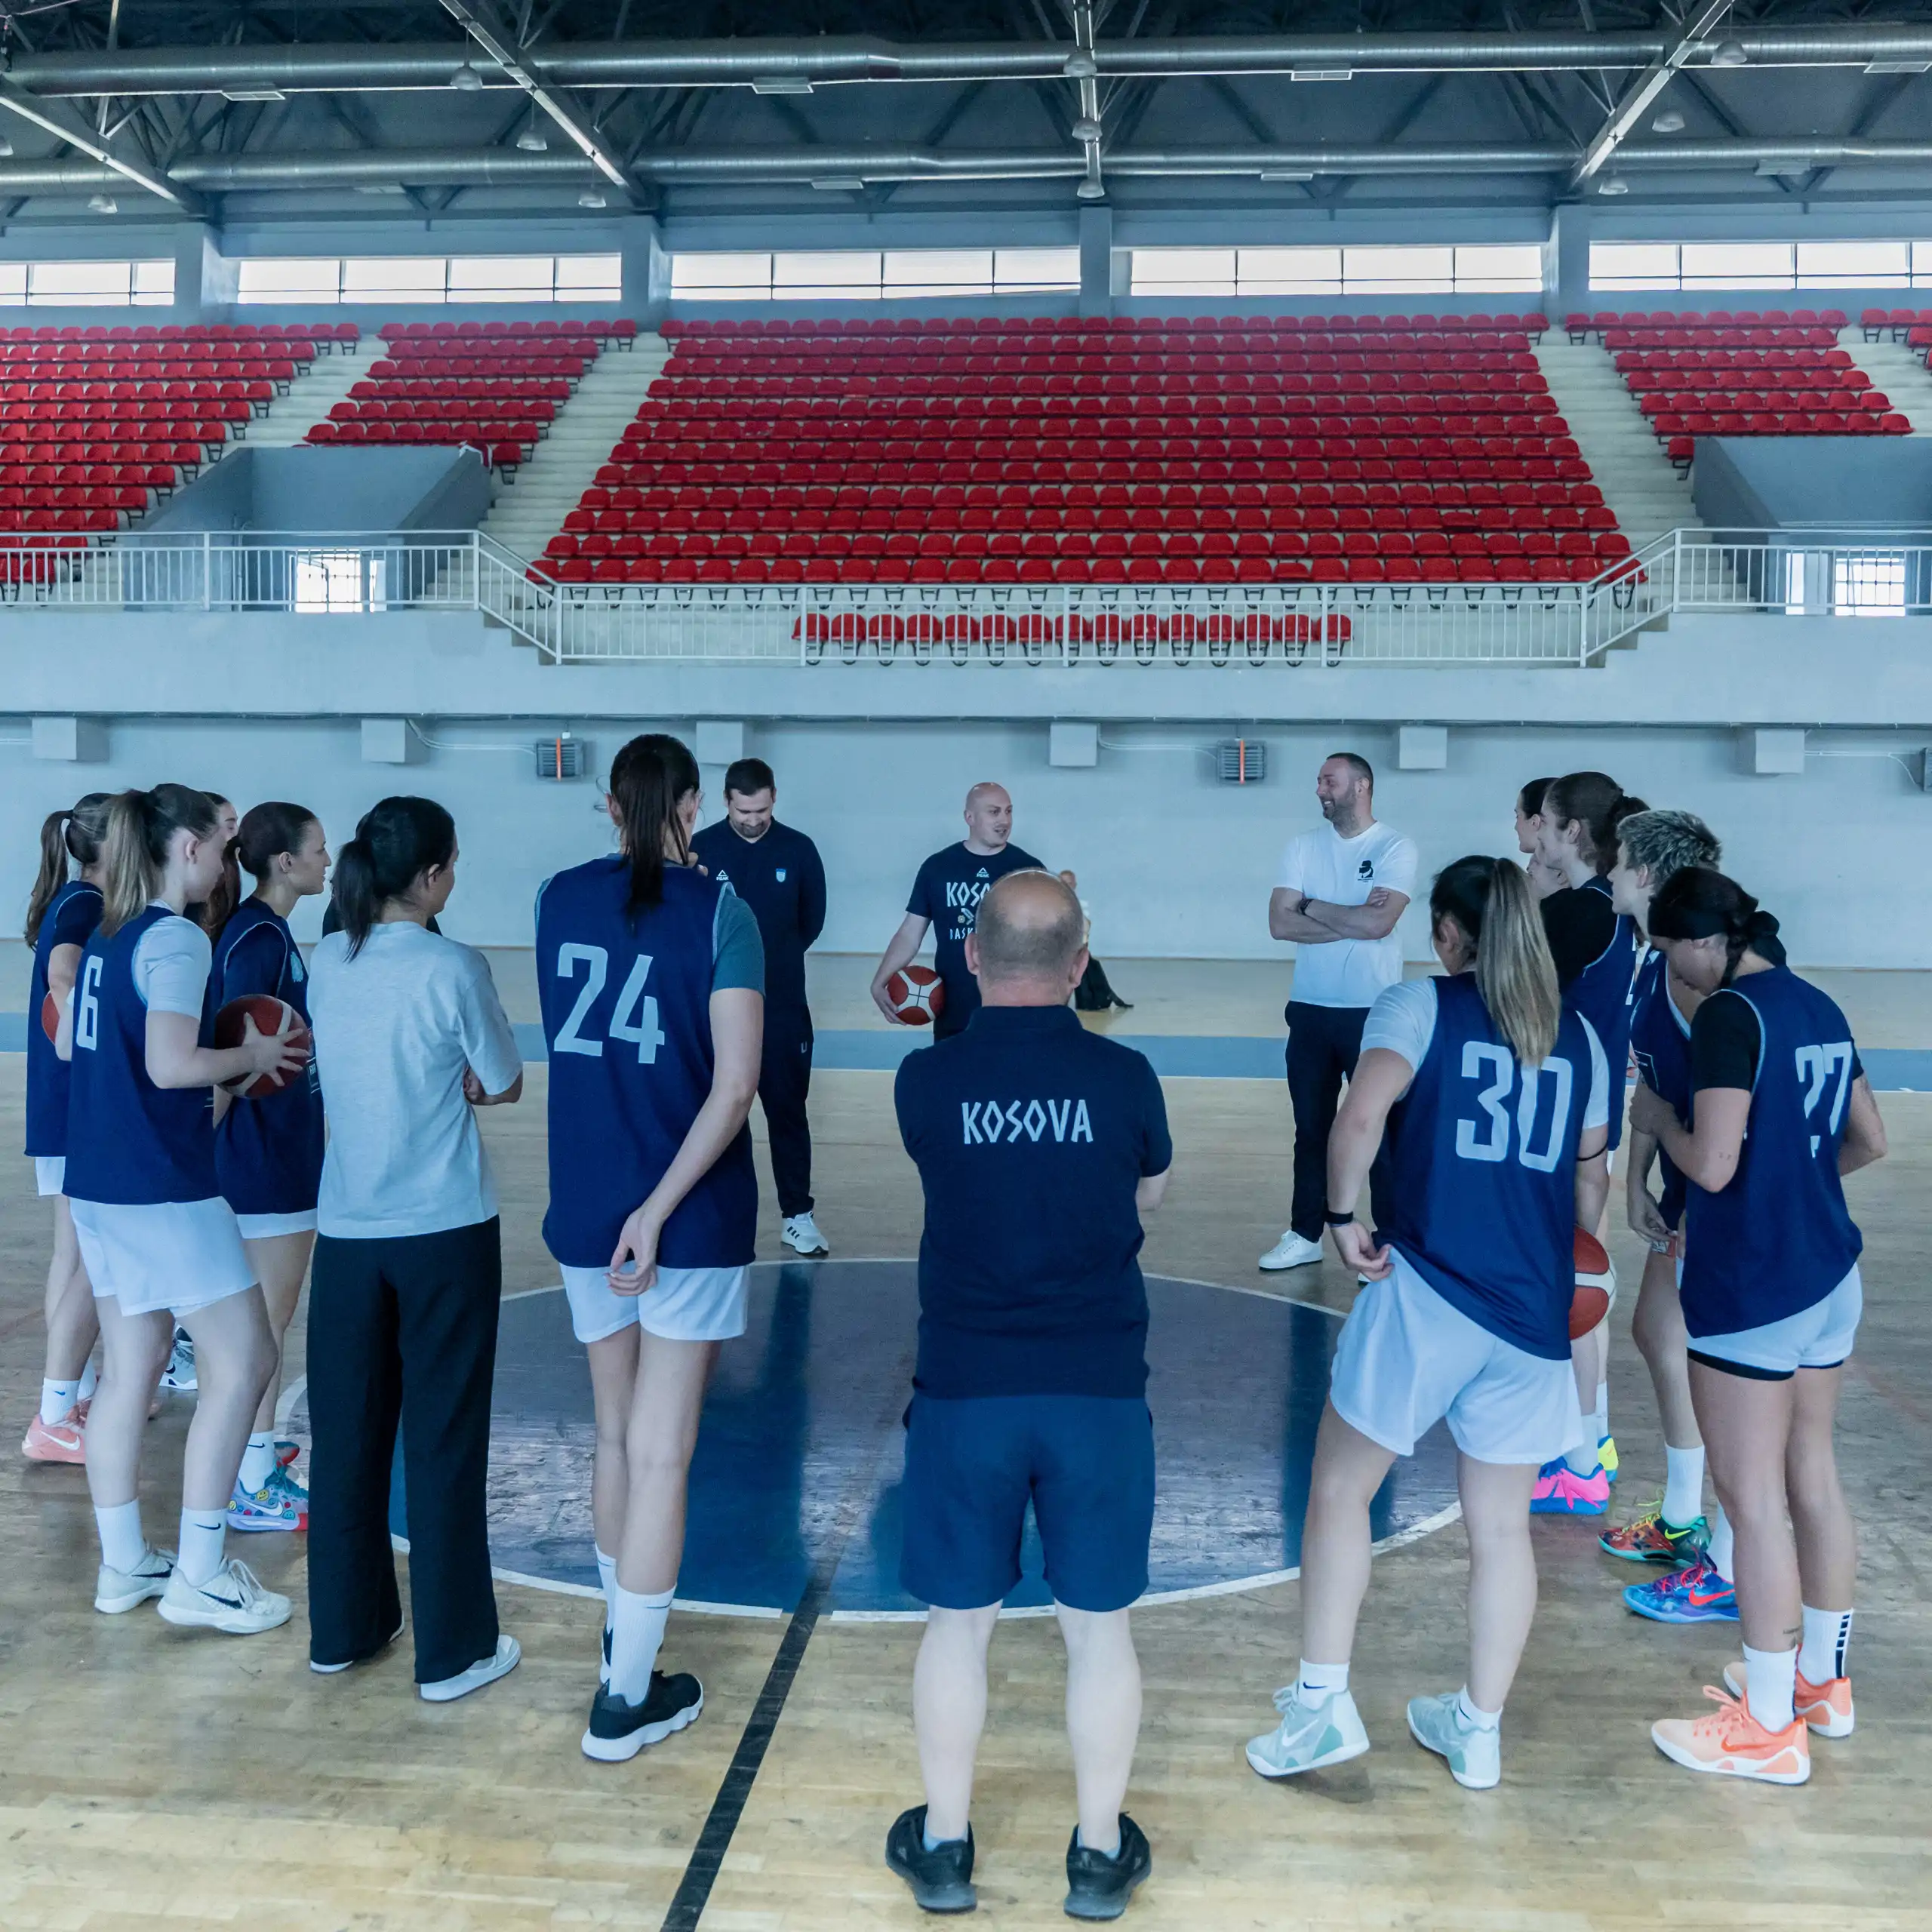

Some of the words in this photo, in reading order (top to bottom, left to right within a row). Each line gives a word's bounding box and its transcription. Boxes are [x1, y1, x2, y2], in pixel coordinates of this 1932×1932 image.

[76, 955, 103, 1051] 6
[554, 943, 665, 1064] 24
[961, 1099, 1094, 1144] KOSOVA
[1456, 1041, 1573, 1173] 30
